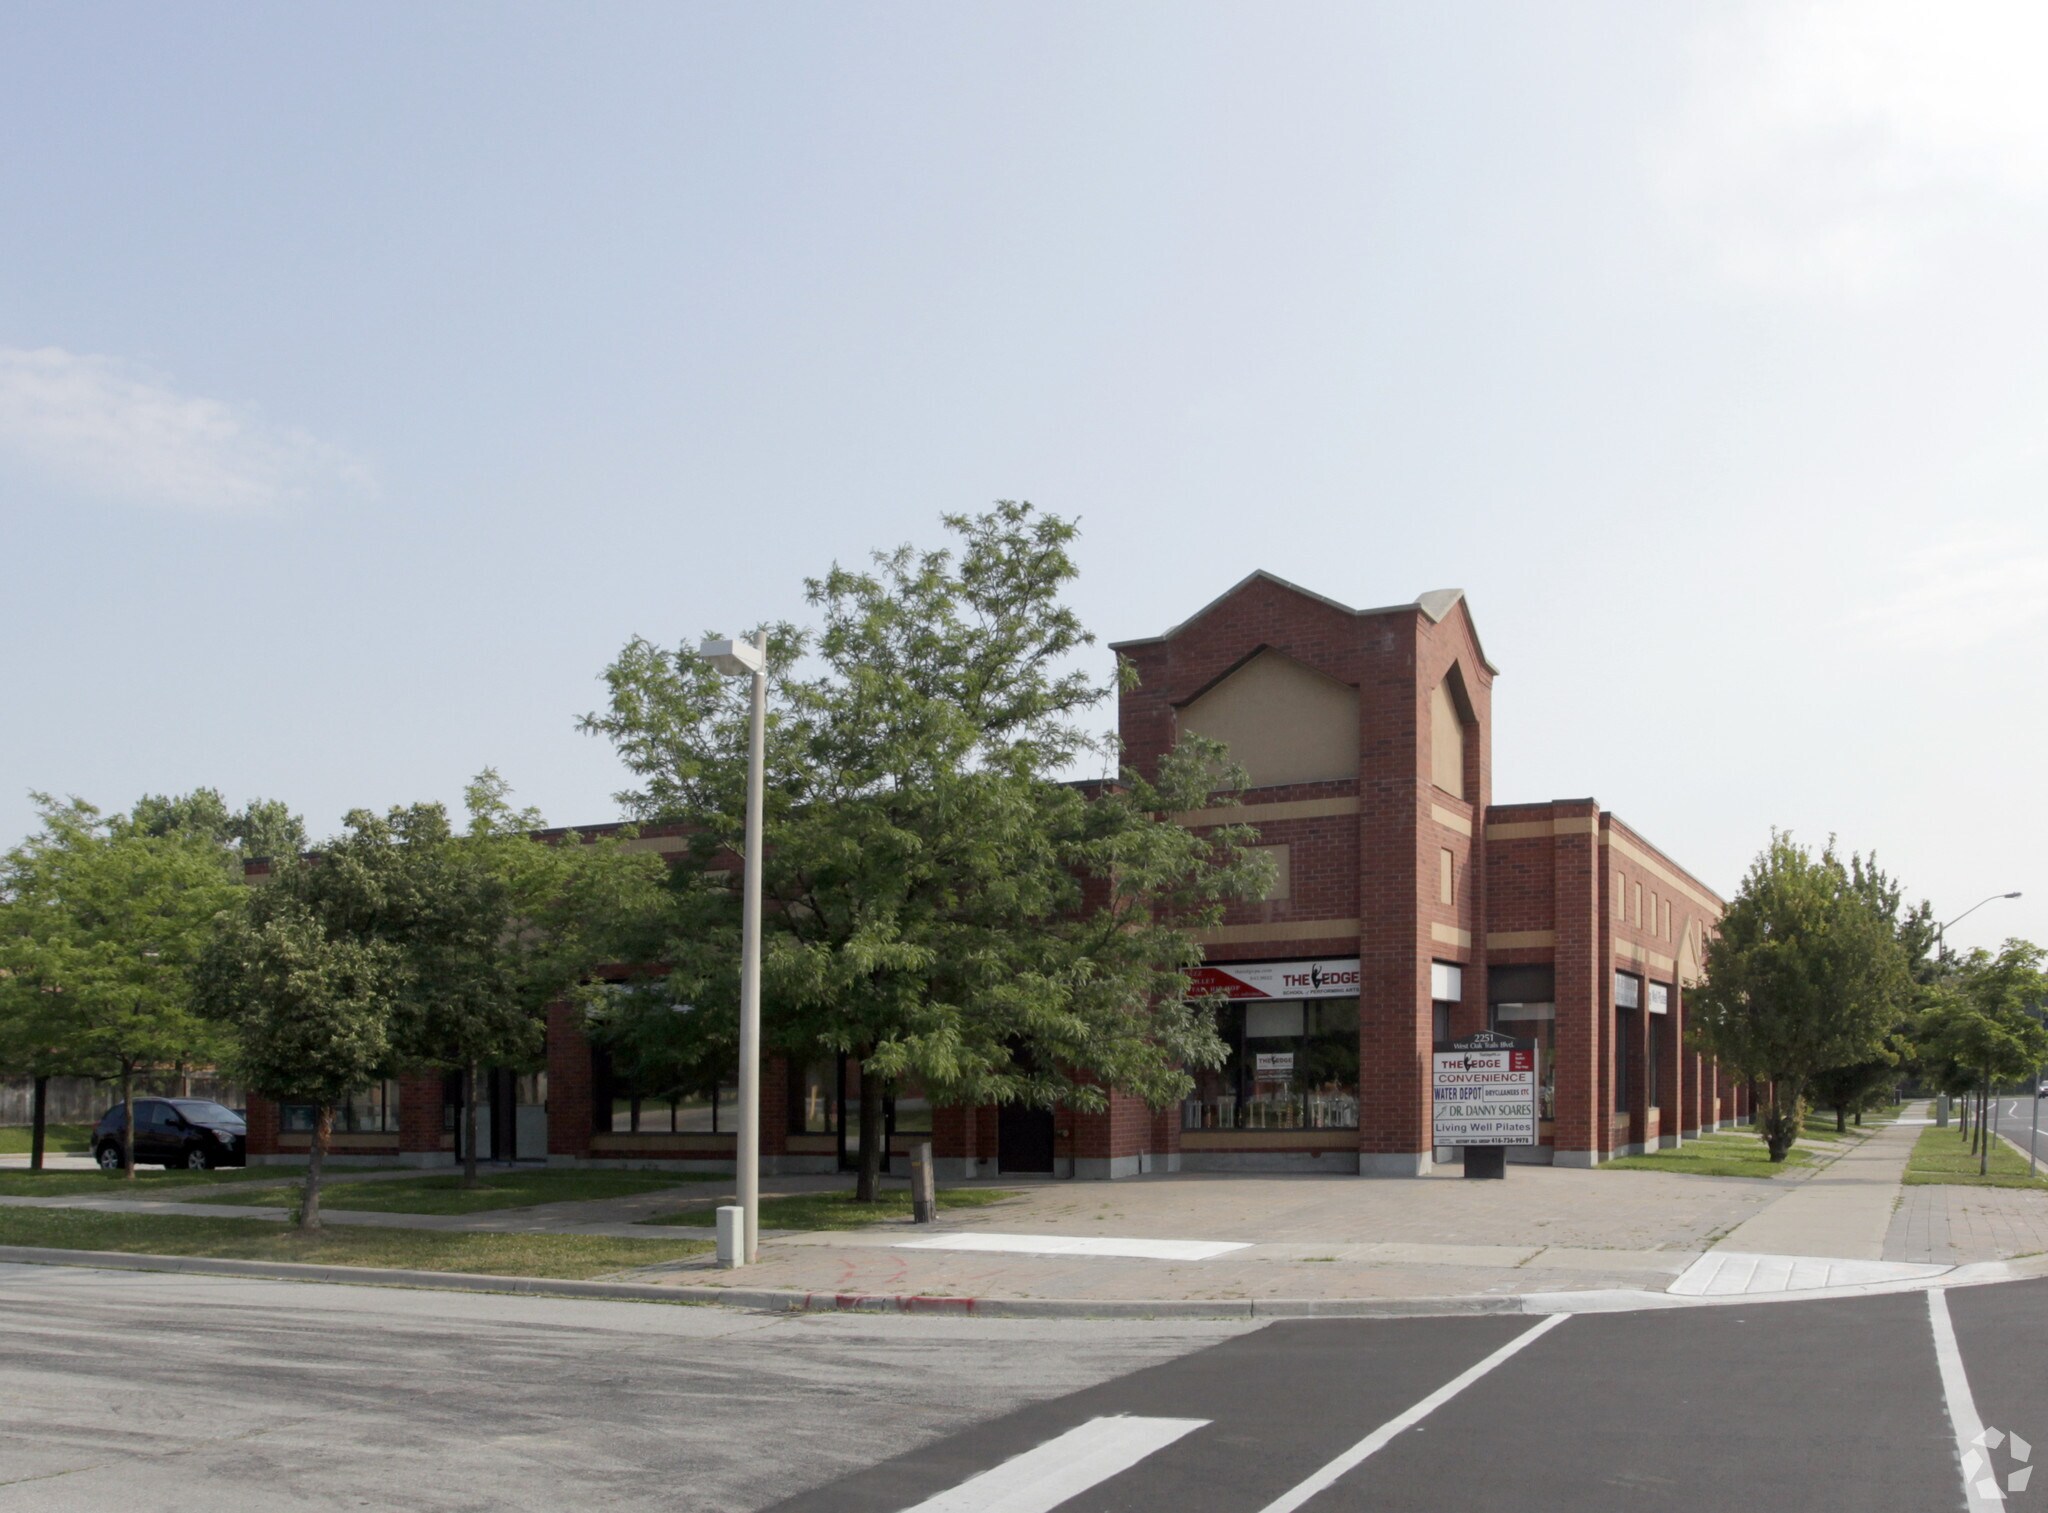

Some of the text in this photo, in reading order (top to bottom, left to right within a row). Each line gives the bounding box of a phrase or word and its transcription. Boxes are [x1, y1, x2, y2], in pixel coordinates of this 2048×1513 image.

[1283, 971, 1360, 987] THE EDGE
[1474, 1034, 1494, 1043] 2251
[1453, 1042, 1469, 1050] West
[1484, 1041, 1499, 1049] Trails
[1441, 1059, 1501, 1069] THE EDGE
[1438, 1073, 1526, 1083] CONVENIENCE
[1434, 1086, 1482, 1100] WATER DEPOT
[1465, 1105, 1497, 1116] DANNY
[1498, 1104, 1532, 1116] SOARES
[1435, 1122, 1531, 1134] Living Well Pilates
